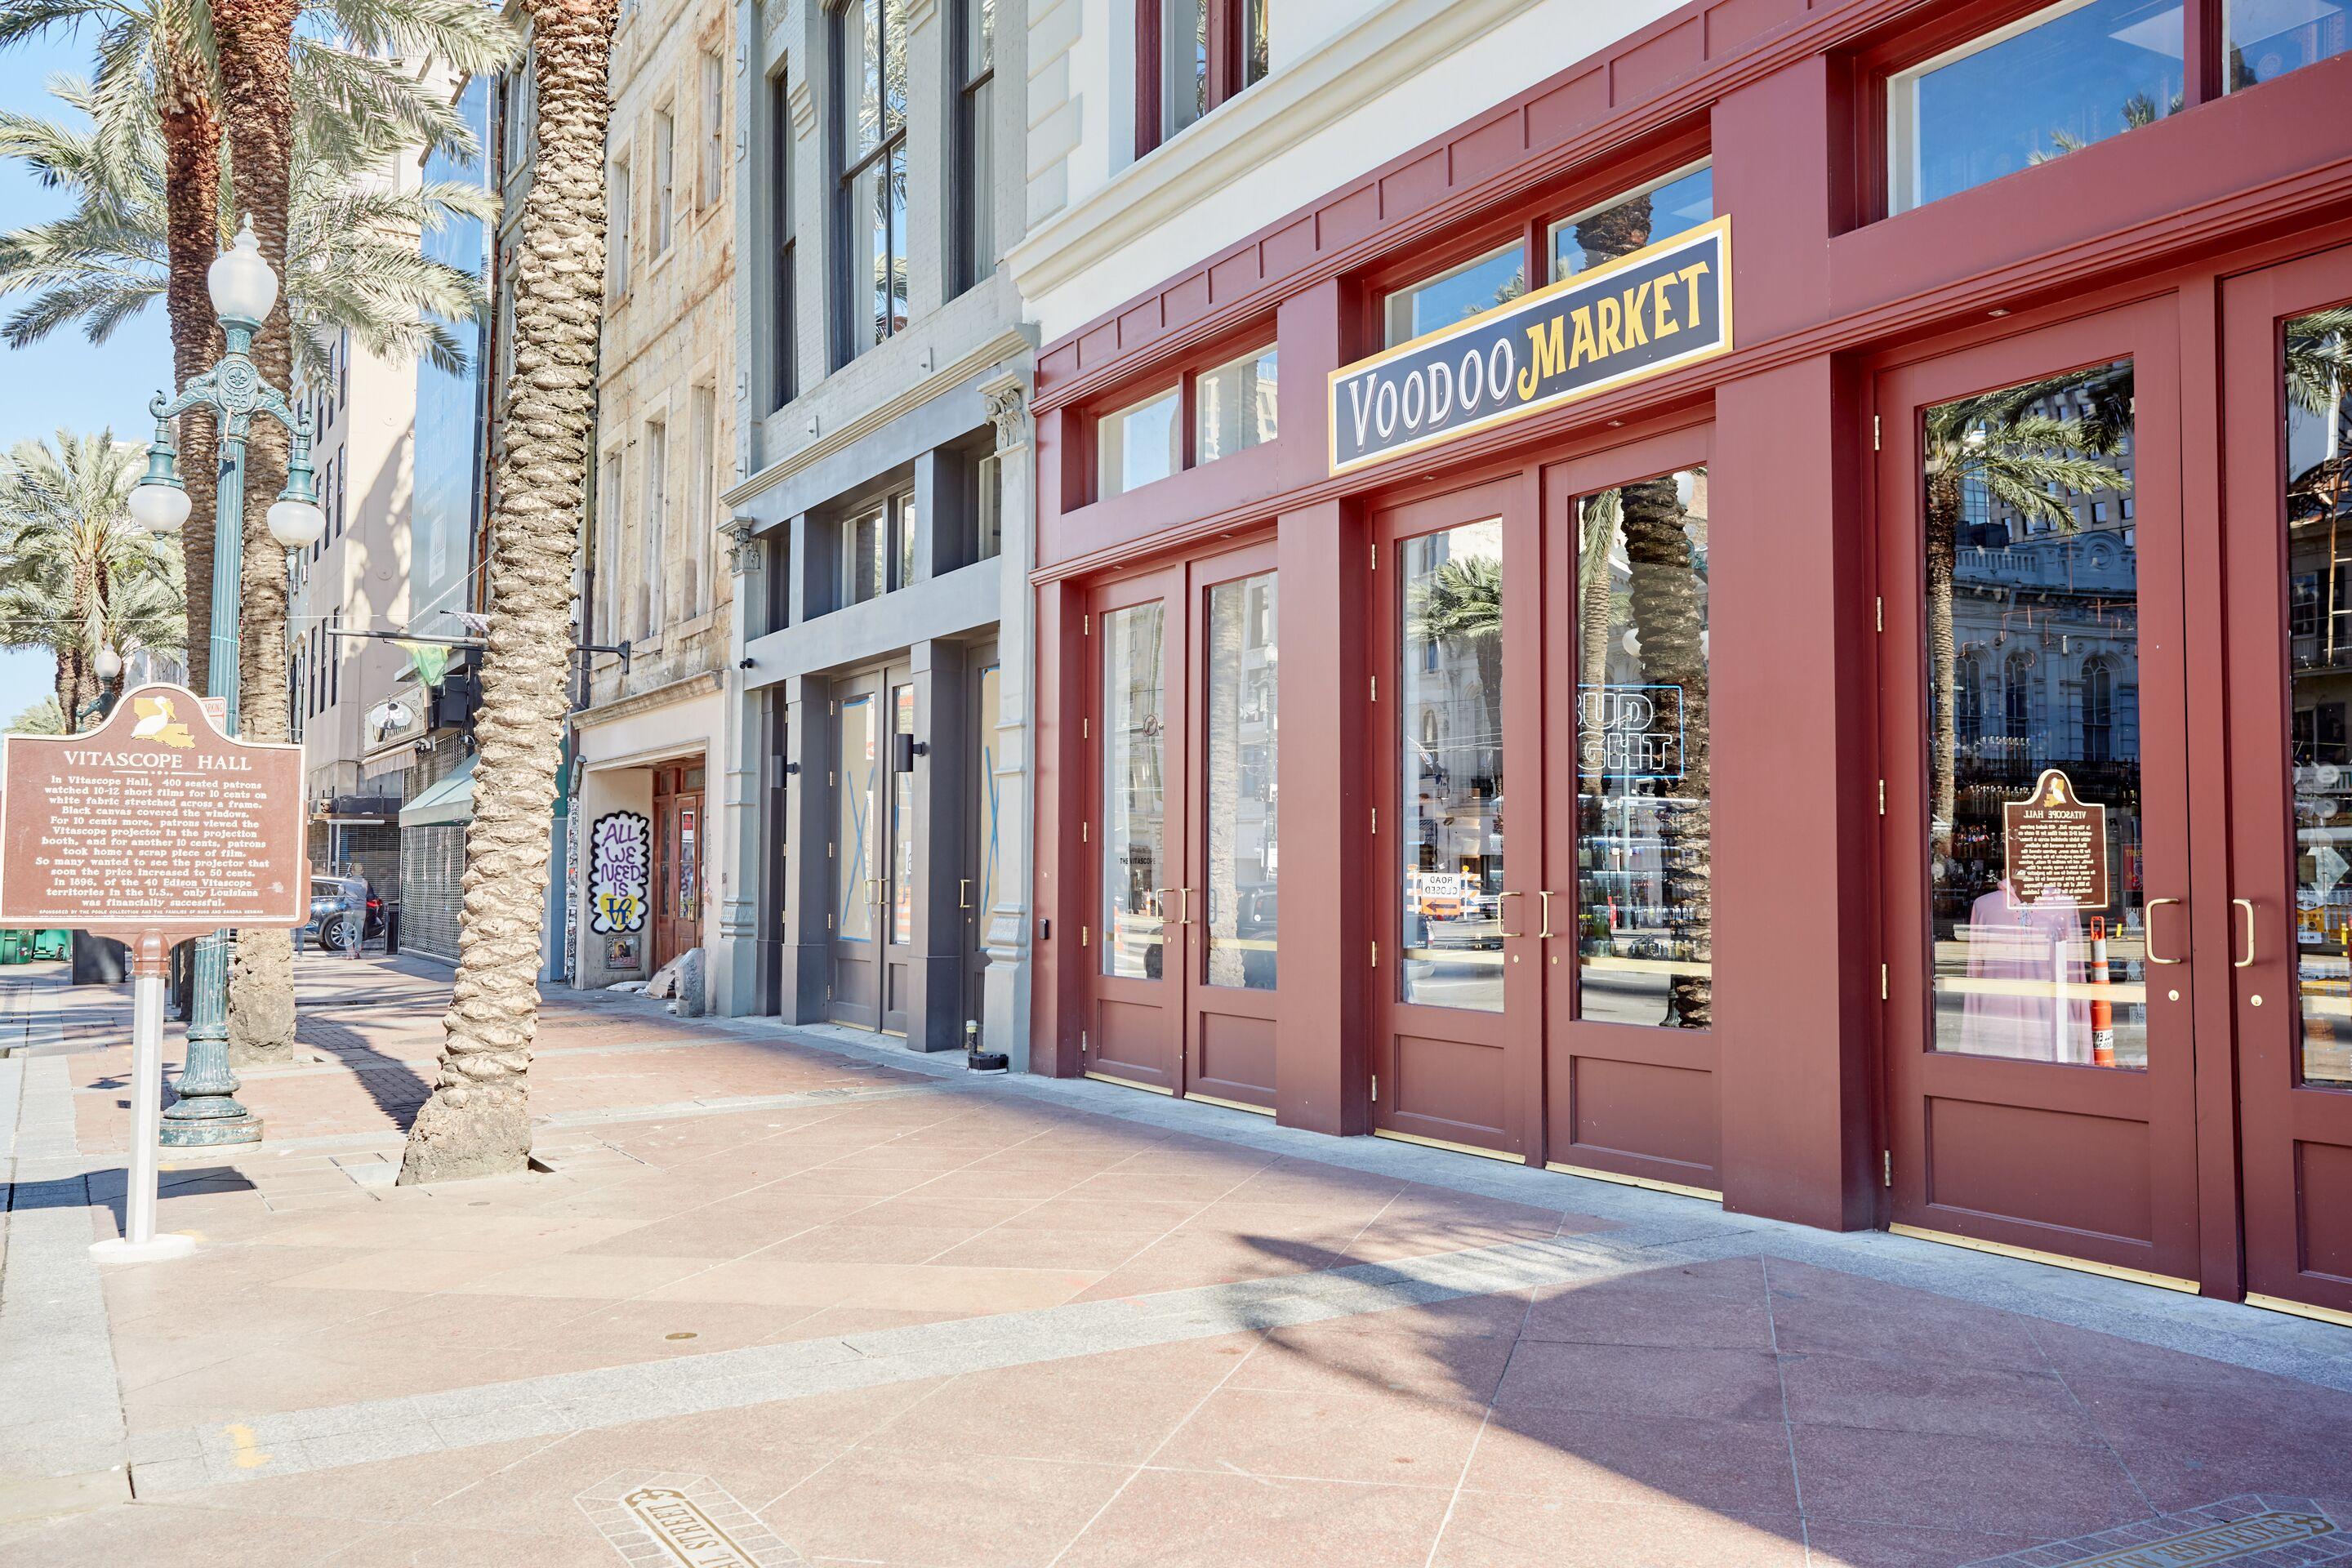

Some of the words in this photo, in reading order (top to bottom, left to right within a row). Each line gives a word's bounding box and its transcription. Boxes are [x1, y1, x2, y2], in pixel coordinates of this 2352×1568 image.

[1348, 337, 1516, 446] VOODOO
[1517, 261, 1711, 402] MARKET
[204, 702, 223, 713] ARKING
[1578, 693, 1654, 730] UD
[1578, 731, 1673, 770] GHT
[64, 751, 183, 768] VITASCOPE
[198, 755, 252, 771] HALL
[51, 775, 62, 783] In
[68, 776, 121, 786] Vitascope
[162, 778, 181, 786] 400
[185, 779, 219, 788] seated
[223, 781, 261, 790] patrons
[44, 786, 89, 794] watched
[94, 786, 120, 795] 10-12
[124, 787, 153, 795] short
[157, 788, 185, 797] films
[189, 789, 206, 797] for
[223, 790, 250, 799] cents
[49, 795, 80, 804] white
[86, 796, 119, 805] fabric
[124, 797, 176, 807] stretched
[180, 800, 212, 808] across
[229, 800, 262, 808] frame.
[62, 806, 91, 814] Black
[136, 808, 178, 817] covered
[182, 808, 200, 817] the
[205, 809, 249, 818] windows.
[50, 816, 69, 824] For
[88, 817, 118, 825] cents
[160, 818, 199, 828] patrons
[203, 819, 238, 827] viewed
[242, 820, 260, 828] the
[52, 826, 107, 836] Vitascope
[111, 827, 162, 837] projector
[166, 828, 176, 836] in
[180, 828, 199, 836] the
[203, 829, 257, 839] projection
[602, 823, 638, 847] ALL
[41, 836, 78, 845] booth,
[87, 837, 106, 845] and
[111, 837, 127, 845] for
[131, 838, 173, 846] another
[189, 840, 220, 848] cents,
[227, 840, 266, 849] patrons
[62, 847, 88, 855] took
[93, 848, 122, 856] home
[139, 849, 167, 858] scrap
[172, 849, 200, 858] piece
[220, 849, 247, 858] film.
[605, 846, 636, 864] WE
[35, 857, 50, 865] So
[90, 858, 129, 866] wanted
[172, 858, 190, 866] the
[194, 859, 244, 868] projector
[247, 859, 270, 867] that
[81, 867, 100, 875] the
[105, 867, 132, 877] price
[137, 868, 189, 876] increased
[225, 869, 255, 877] cents.
[601, 863, 641, 882] NEED
[54, 877, 65, 885] In
[121, 878, 139, 886] the
[144, 878, 158, 886] 40
[163, 878, 198, 887] Edison
[201, 879, 252, 889] Vitascope
[613, 882, 628, 897] IS
[46, 888, 105, 896] territories
[109, 888, 121, 896] in
[125, 888, 144, 896] the
[183, 888, 207, 897] only
[210, 888, 259, 897] Louisiana
[106, 898, 165, 906] financially
[170, 898, 225, 906] successful.
[646, 1503, 719, 1550] STREET
[2152, 1519, 2306, 1561] EXCHANGE
